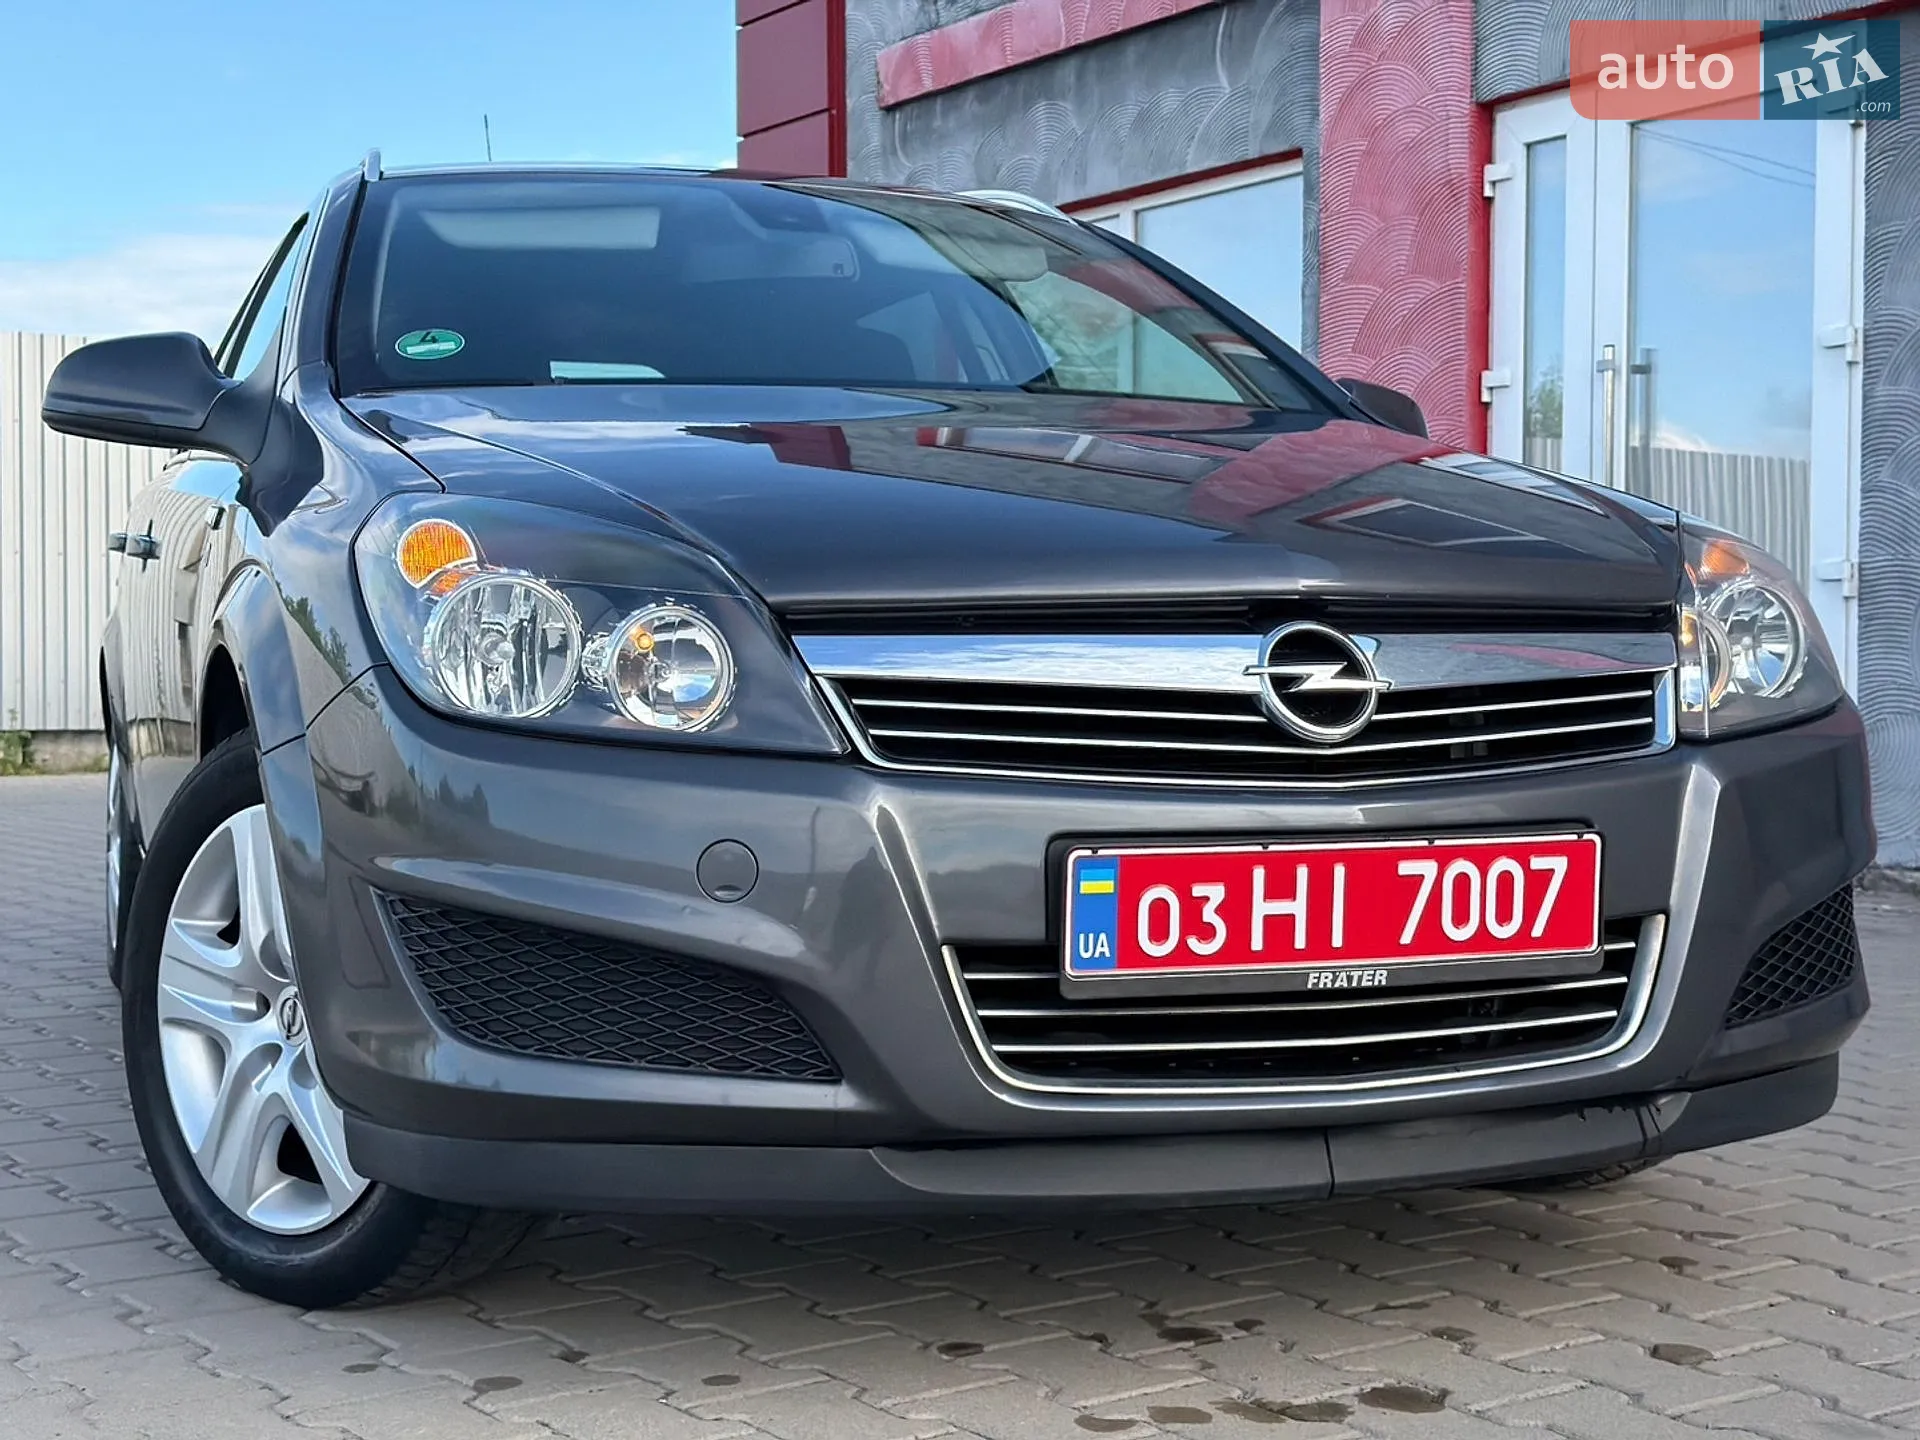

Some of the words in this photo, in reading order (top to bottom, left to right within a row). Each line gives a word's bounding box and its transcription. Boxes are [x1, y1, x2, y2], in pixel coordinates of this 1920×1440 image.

[1137, 882, 1227, 958] 03
[1250, 862, 1346, 952] HI
[1397, 854, 1568, 945] 7007
[1078, 932, 1111, 959] UA
